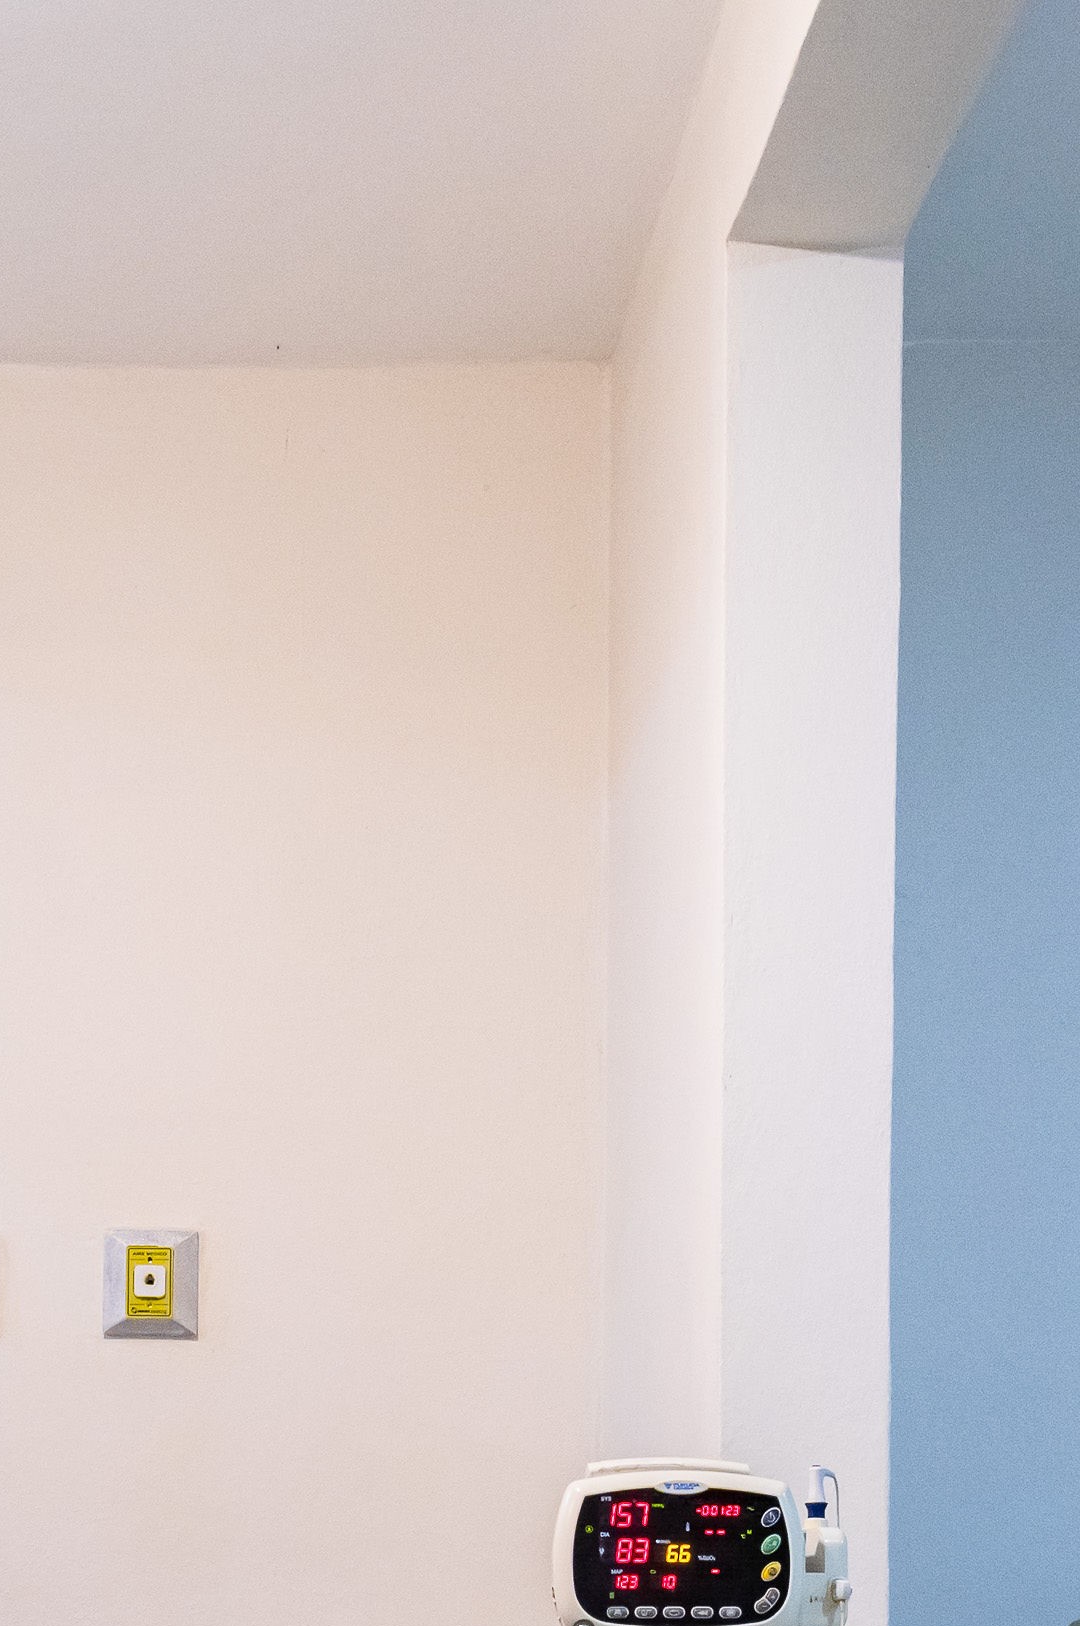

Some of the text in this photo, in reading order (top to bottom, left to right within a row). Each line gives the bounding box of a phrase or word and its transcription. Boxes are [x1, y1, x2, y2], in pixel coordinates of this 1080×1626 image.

[610, 1502, 650, 1528] 157
[616, 1538, 650, 1563] 83
[666, 1544, 691, 1563] 66
[615, 1574, 677, 1589] 123 10
